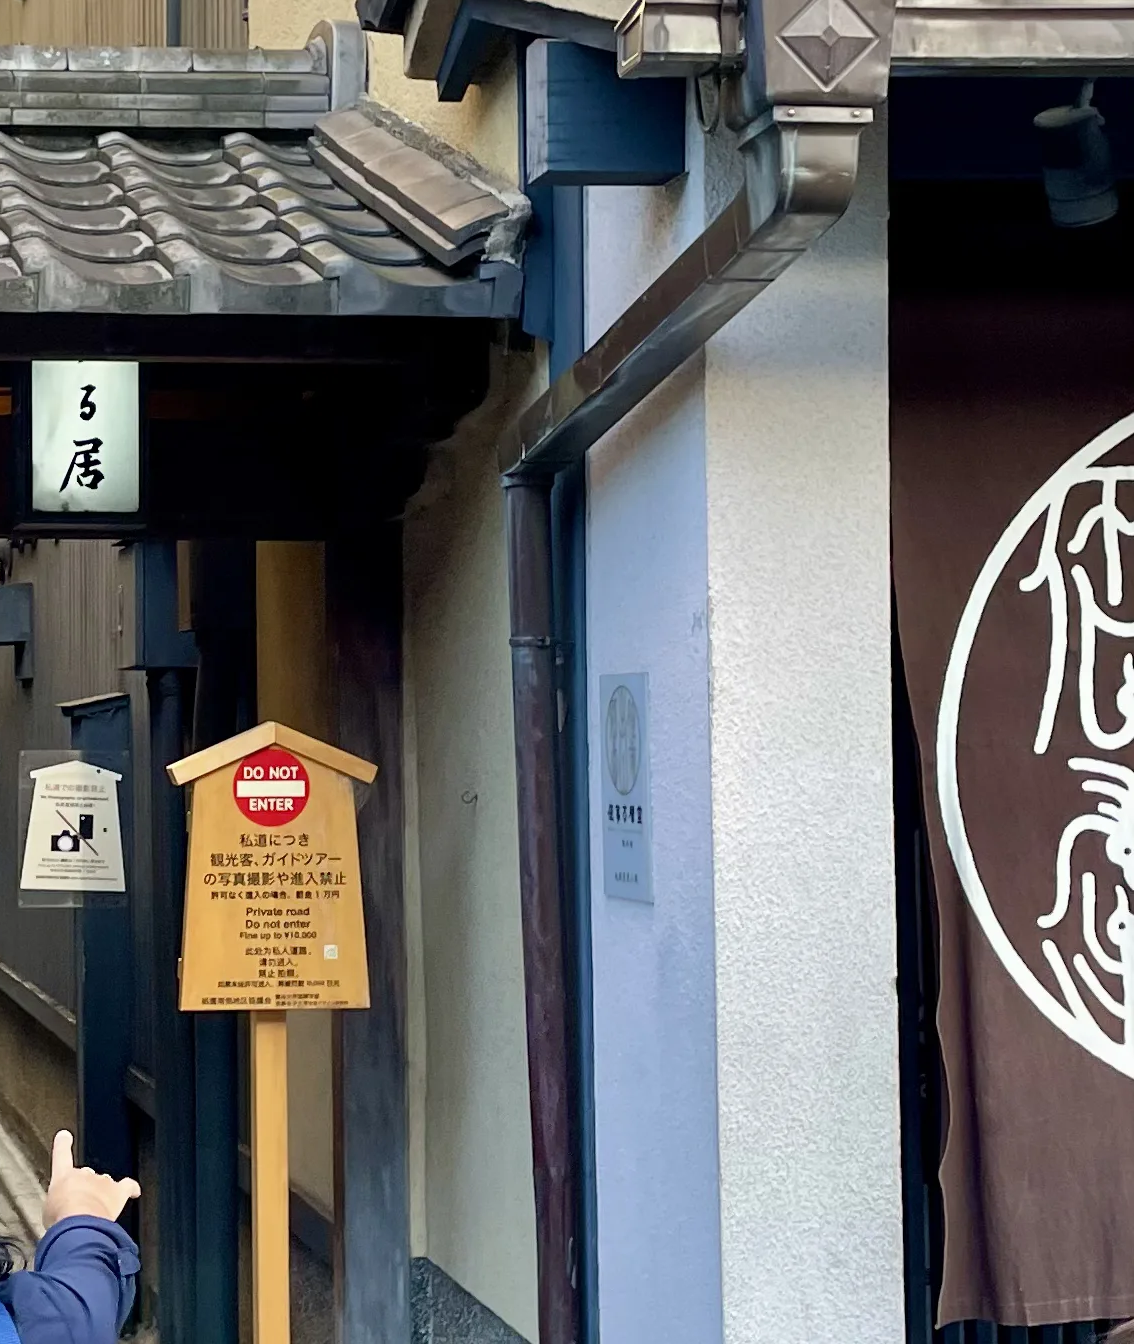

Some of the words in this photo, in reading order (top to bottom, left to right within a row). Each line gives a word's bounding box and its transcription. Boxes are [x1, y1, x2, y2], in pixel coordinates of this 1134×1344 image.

[243, 765, 264, 779] DO
[269, 765, 299, 779] NOT
[249, 798, 294, 812] ENTER
[239, 833, 309, 847] 私道につき
[210, 852, 342, 867] 観光客、ガイドツアー
[203, 872, 346, 886] の写真撮影や進入禁止
[246, 907, 283, 916] Private
[286, 907, 310, 916] road
[245, 920, 261, 929] Do
[263, 920, 281, 929] not
[283, 920, 311, 929] enter
[260, 933, 271, 941] up
